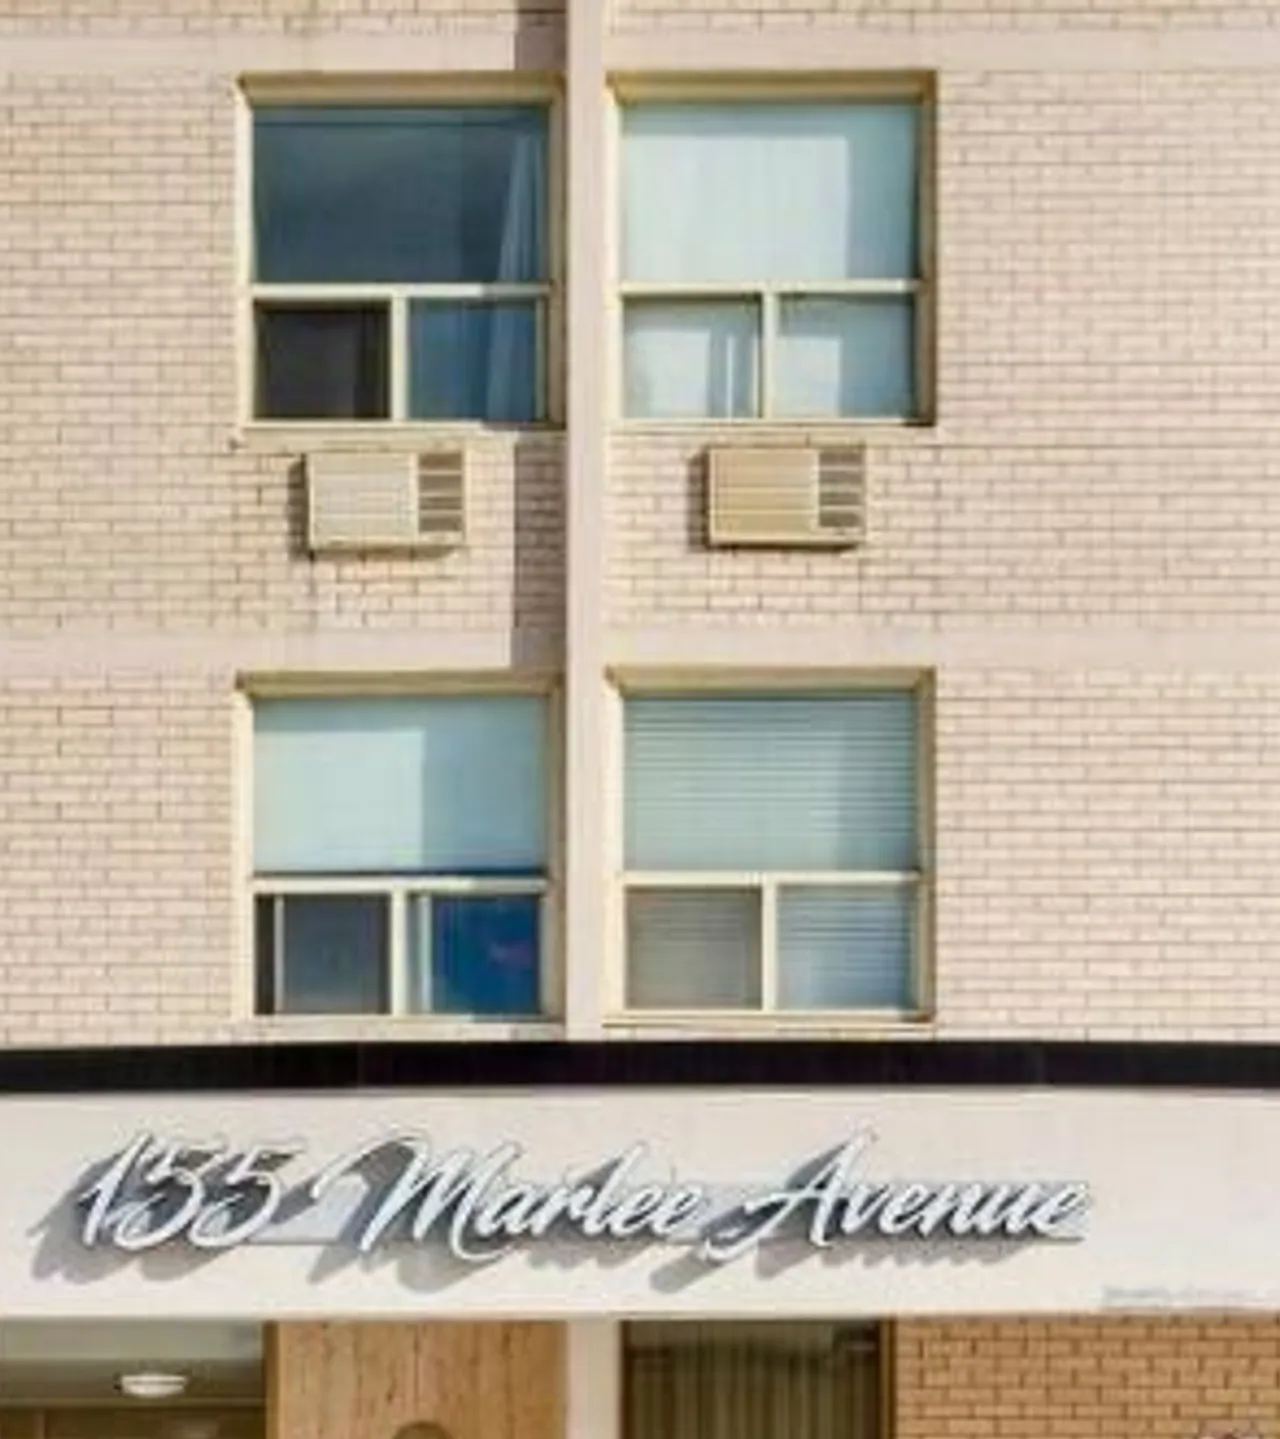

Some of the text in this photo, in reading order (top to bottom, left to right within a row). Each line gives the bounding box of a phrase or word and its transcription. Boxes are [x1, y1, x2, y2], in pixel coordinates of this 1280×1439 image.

[83, 1128, 1091, 1262] 155 Marlee Avenue
